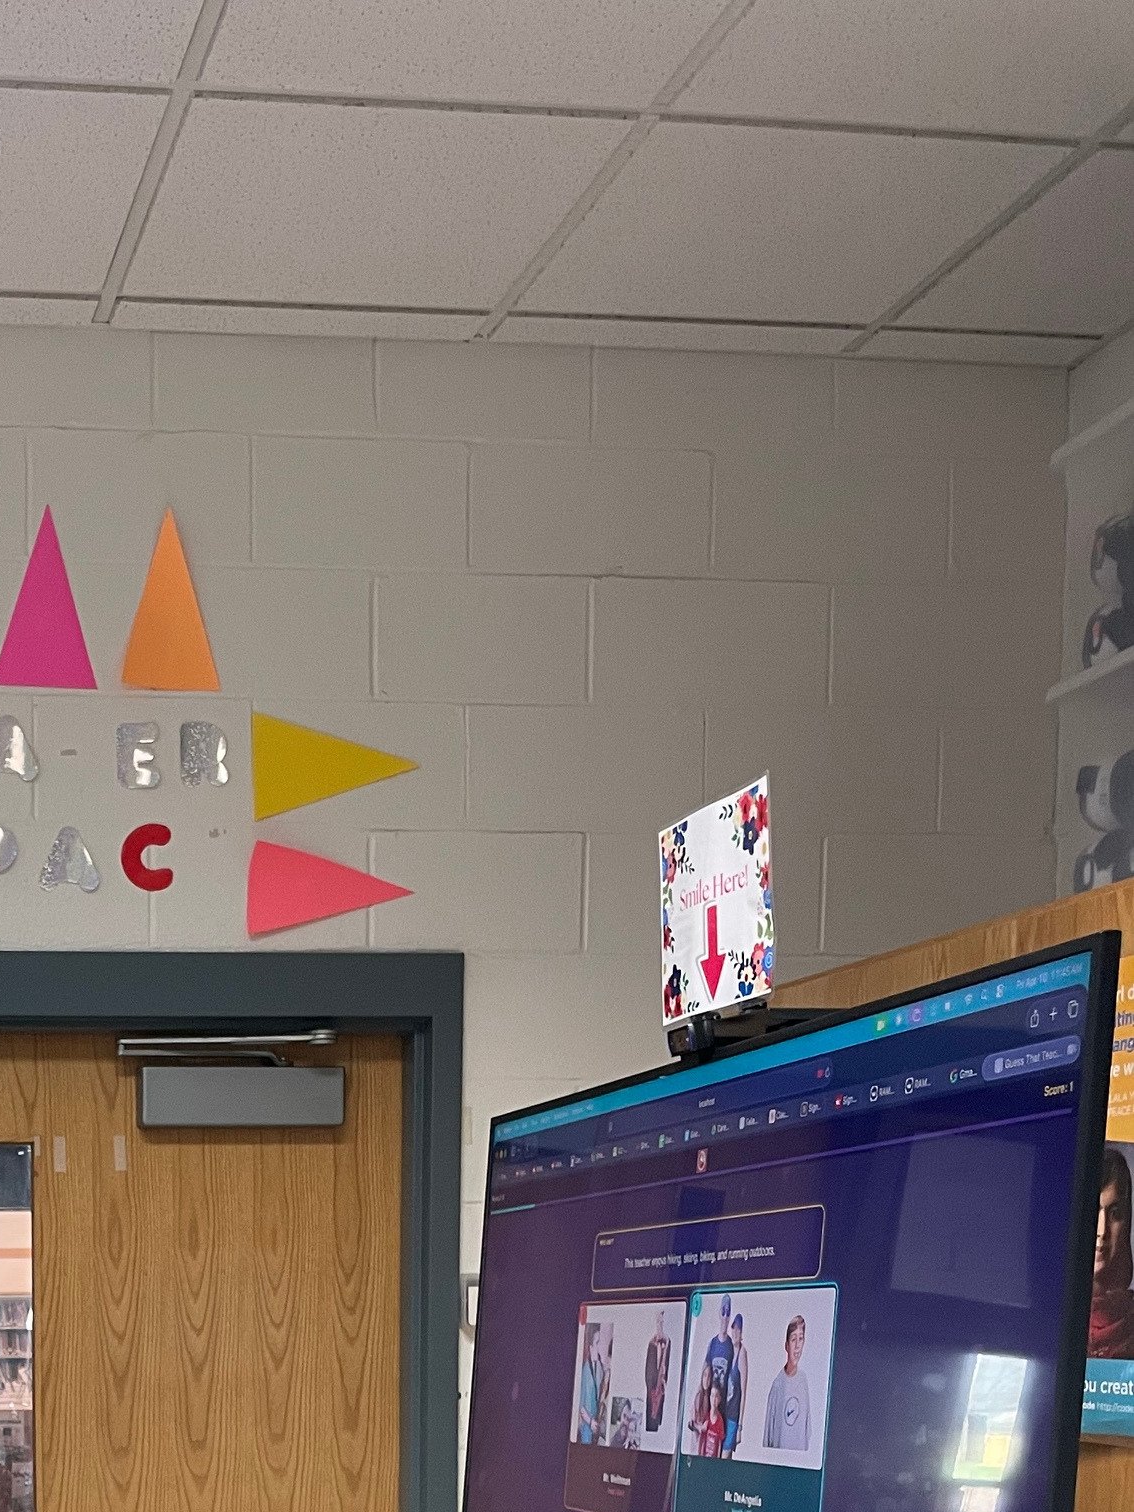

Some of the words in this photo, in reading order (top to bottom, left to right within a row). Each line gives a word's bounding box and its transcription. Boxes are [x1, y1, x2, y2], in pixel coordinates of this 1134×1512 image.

[679, 878, 710, 912] Smile
[712, 864, 750, 900] Here!
[1100, 1380, 1134, 1396] creat
